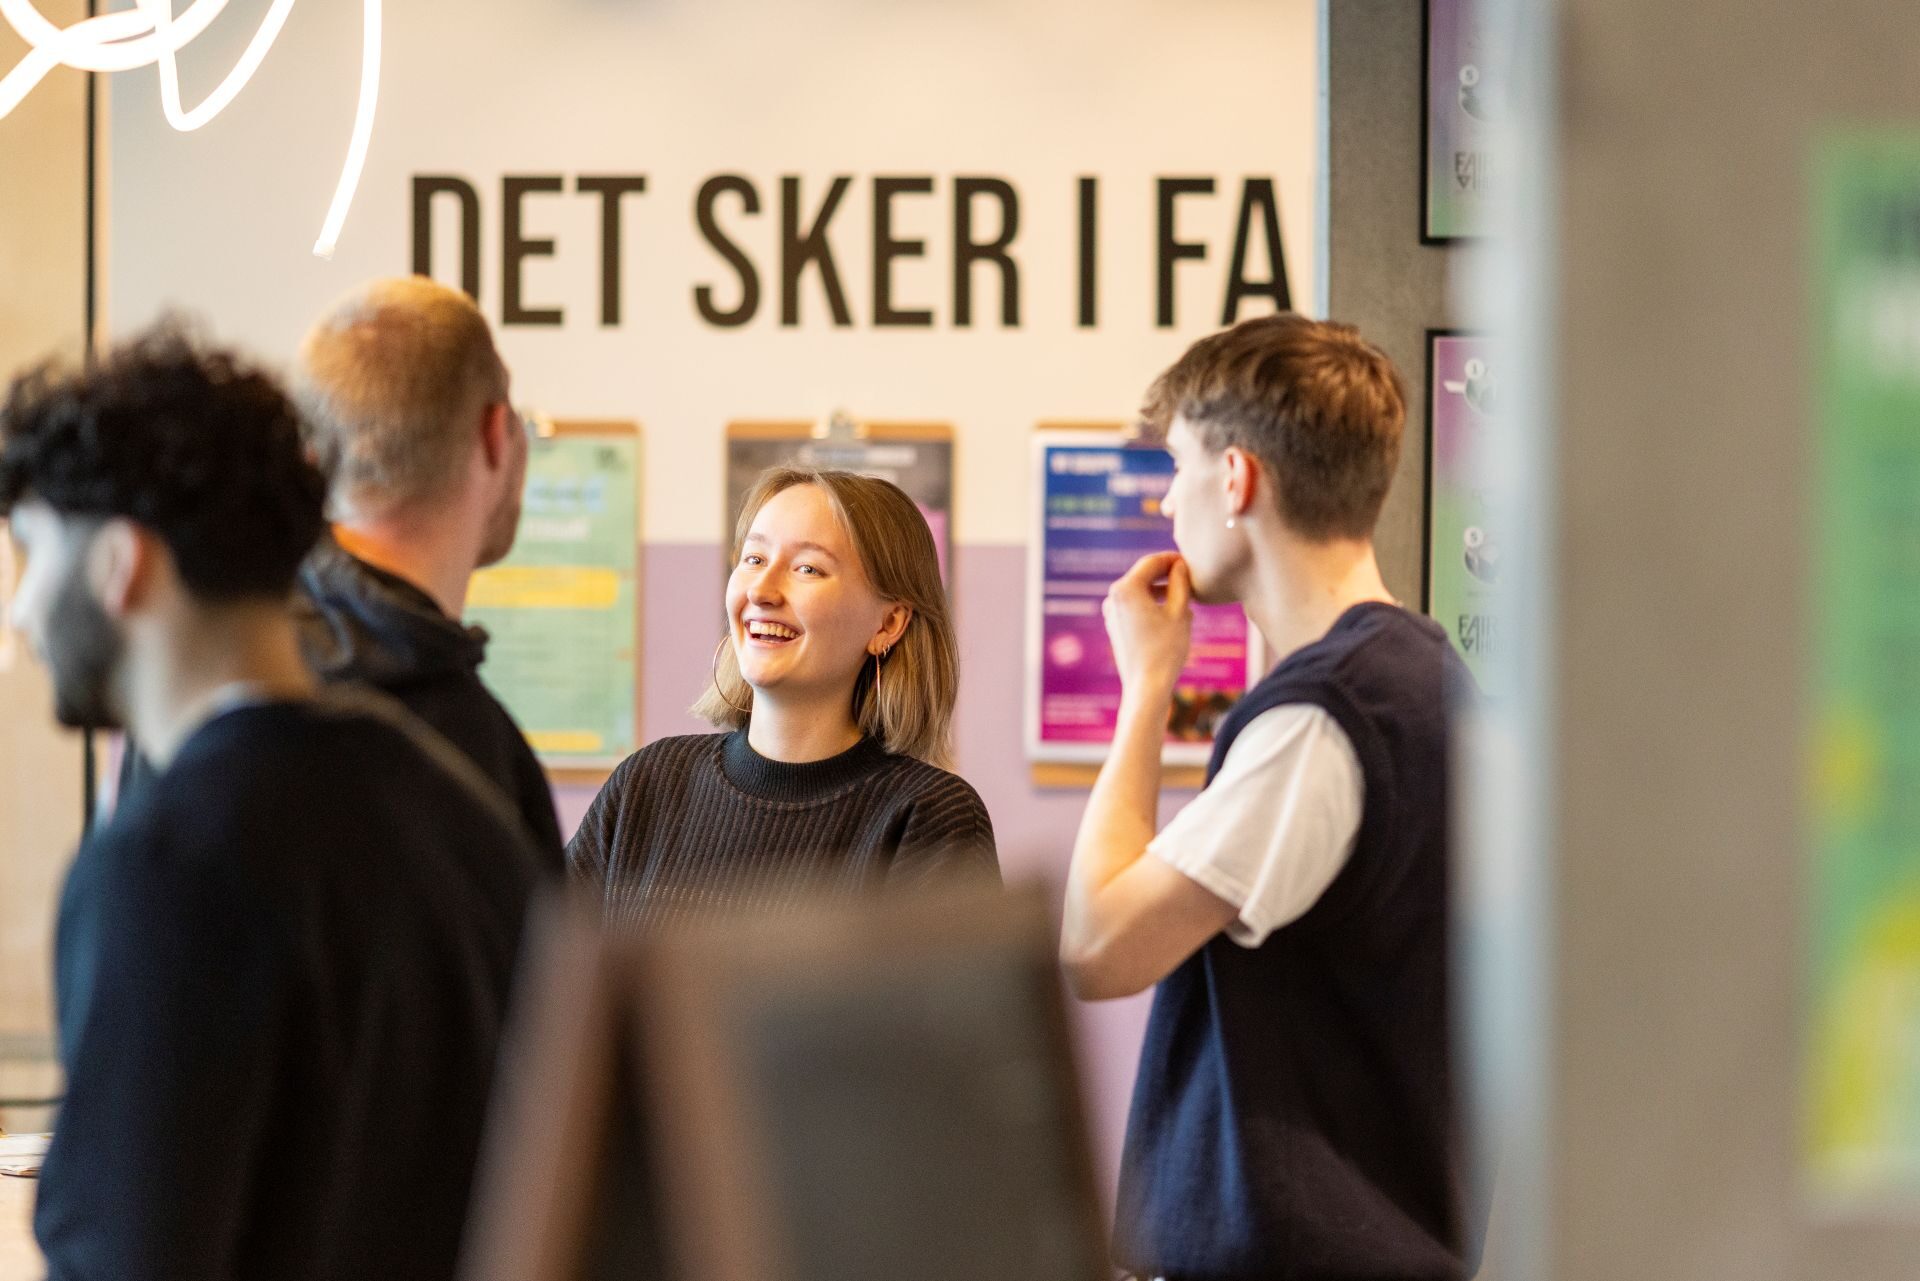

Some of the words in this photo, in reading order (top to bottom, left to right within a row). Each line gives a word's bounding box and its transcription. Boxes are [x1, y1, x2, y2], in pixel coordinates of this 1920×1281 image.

[411, 175, 647, 328] DET
[693, 174, 1023, 329] SKER
[1076, 176, 1098, 329] I
[1155, 176, 1296, 329] FA
